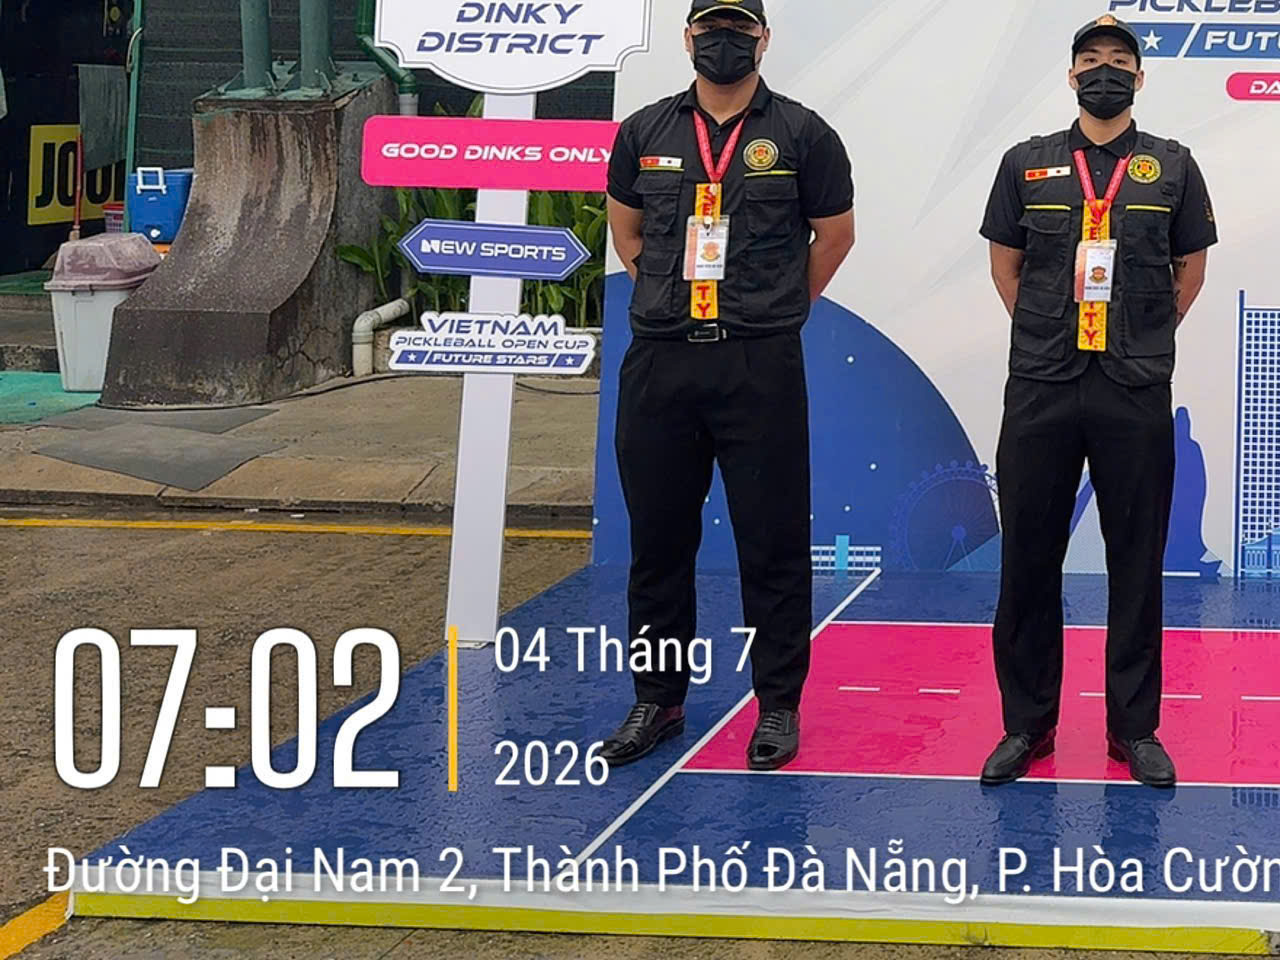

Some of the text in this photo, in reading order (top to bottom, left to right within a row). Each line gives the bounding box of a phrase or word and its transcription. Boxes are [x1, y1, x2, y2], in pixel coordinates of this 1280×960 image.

[456, 2, 584, 25] DINKY
[416, 31, 605, 55] DISTRICT
[381, 143, 612, 163] GOOD DINKS ONLY
[420, 238, 567, 261] NEW SPORTS
[423, 318, 559, 336] VIETNAM
[395, 336, 590, 350] PICKLEBALL OPEN CUP
[432, 351, 551, 366] FUTURE STARS
